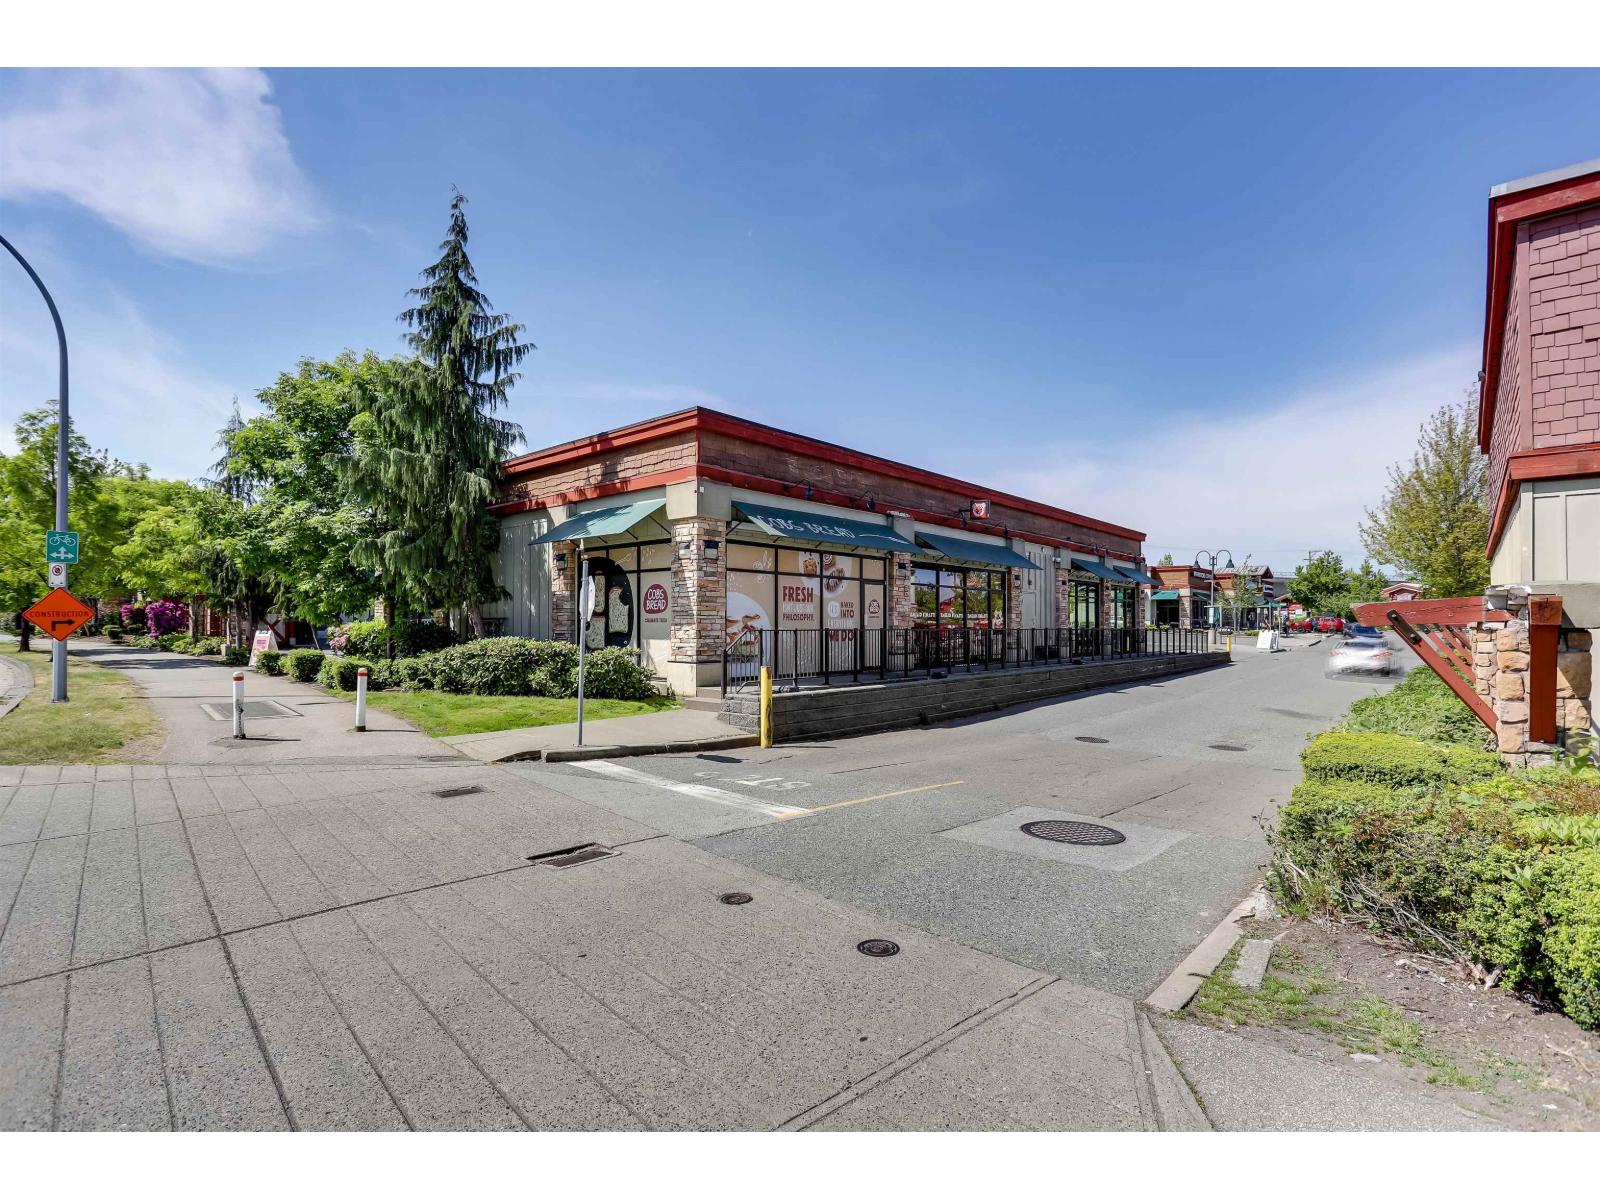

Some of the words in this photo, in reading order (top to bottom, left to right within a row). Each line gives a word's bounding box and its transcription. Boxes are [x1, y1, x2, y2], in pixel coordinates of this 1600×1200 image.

[804, 522, 856, 539] BREAD
[648, 588, 665, 600] COBS
[782, 586, 814, 603] FRESH
[646, 599, 667, 611] BREAD
[30, 610, 89, 618] CONSTRUCTION
[840, 609, 855, 618] INTO
